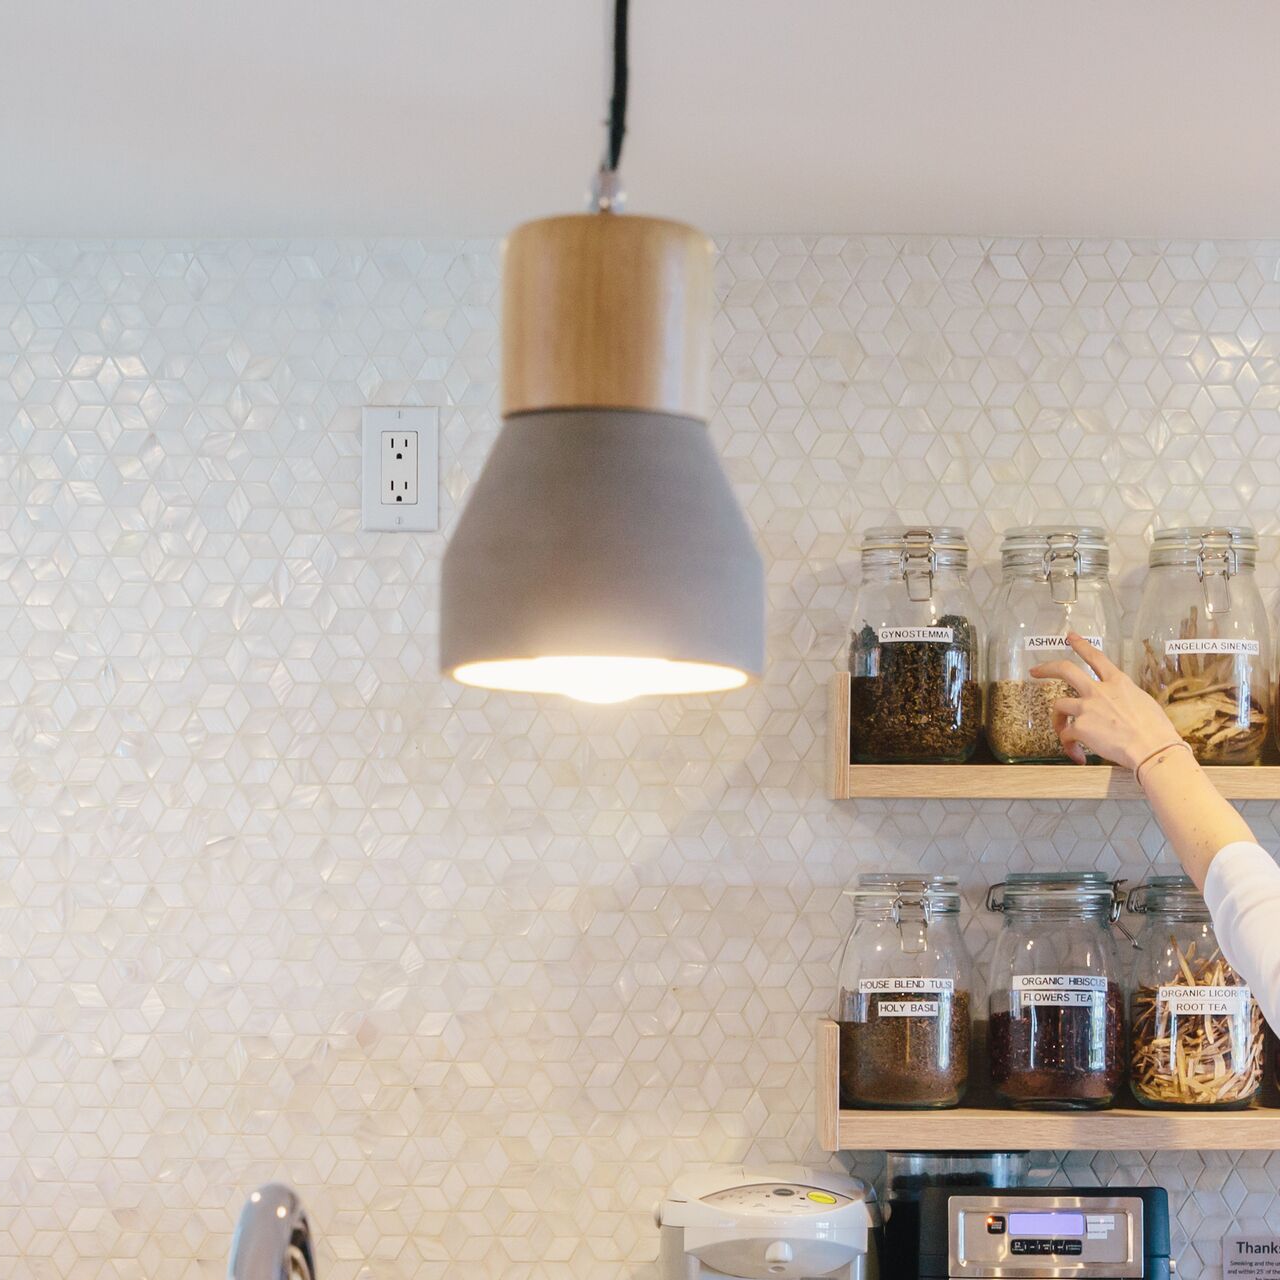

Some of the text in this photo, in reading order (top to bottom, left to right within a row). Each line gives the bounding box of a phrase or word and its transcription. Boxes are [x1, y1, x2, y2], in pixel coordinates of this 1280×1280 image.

[881, 630, 950, 639] GYNOSTEMMA
[1168, 642, 1218, 651] ANGELICA
[860, 981, 889, 989] HOUSE
[894, 980, 925, 989] BLEND
[1022, 977, 1105, 987] ORGANIC HIBISCUS
[1024, 993, 1093, 1002] FLOWERS TEA
[1160, 989, 1206, 998] ORGANIC
[880, 1004, 936, 1012] HOLY BASIL
[1176, 1003, 1228, 1012] ROOT TEA
